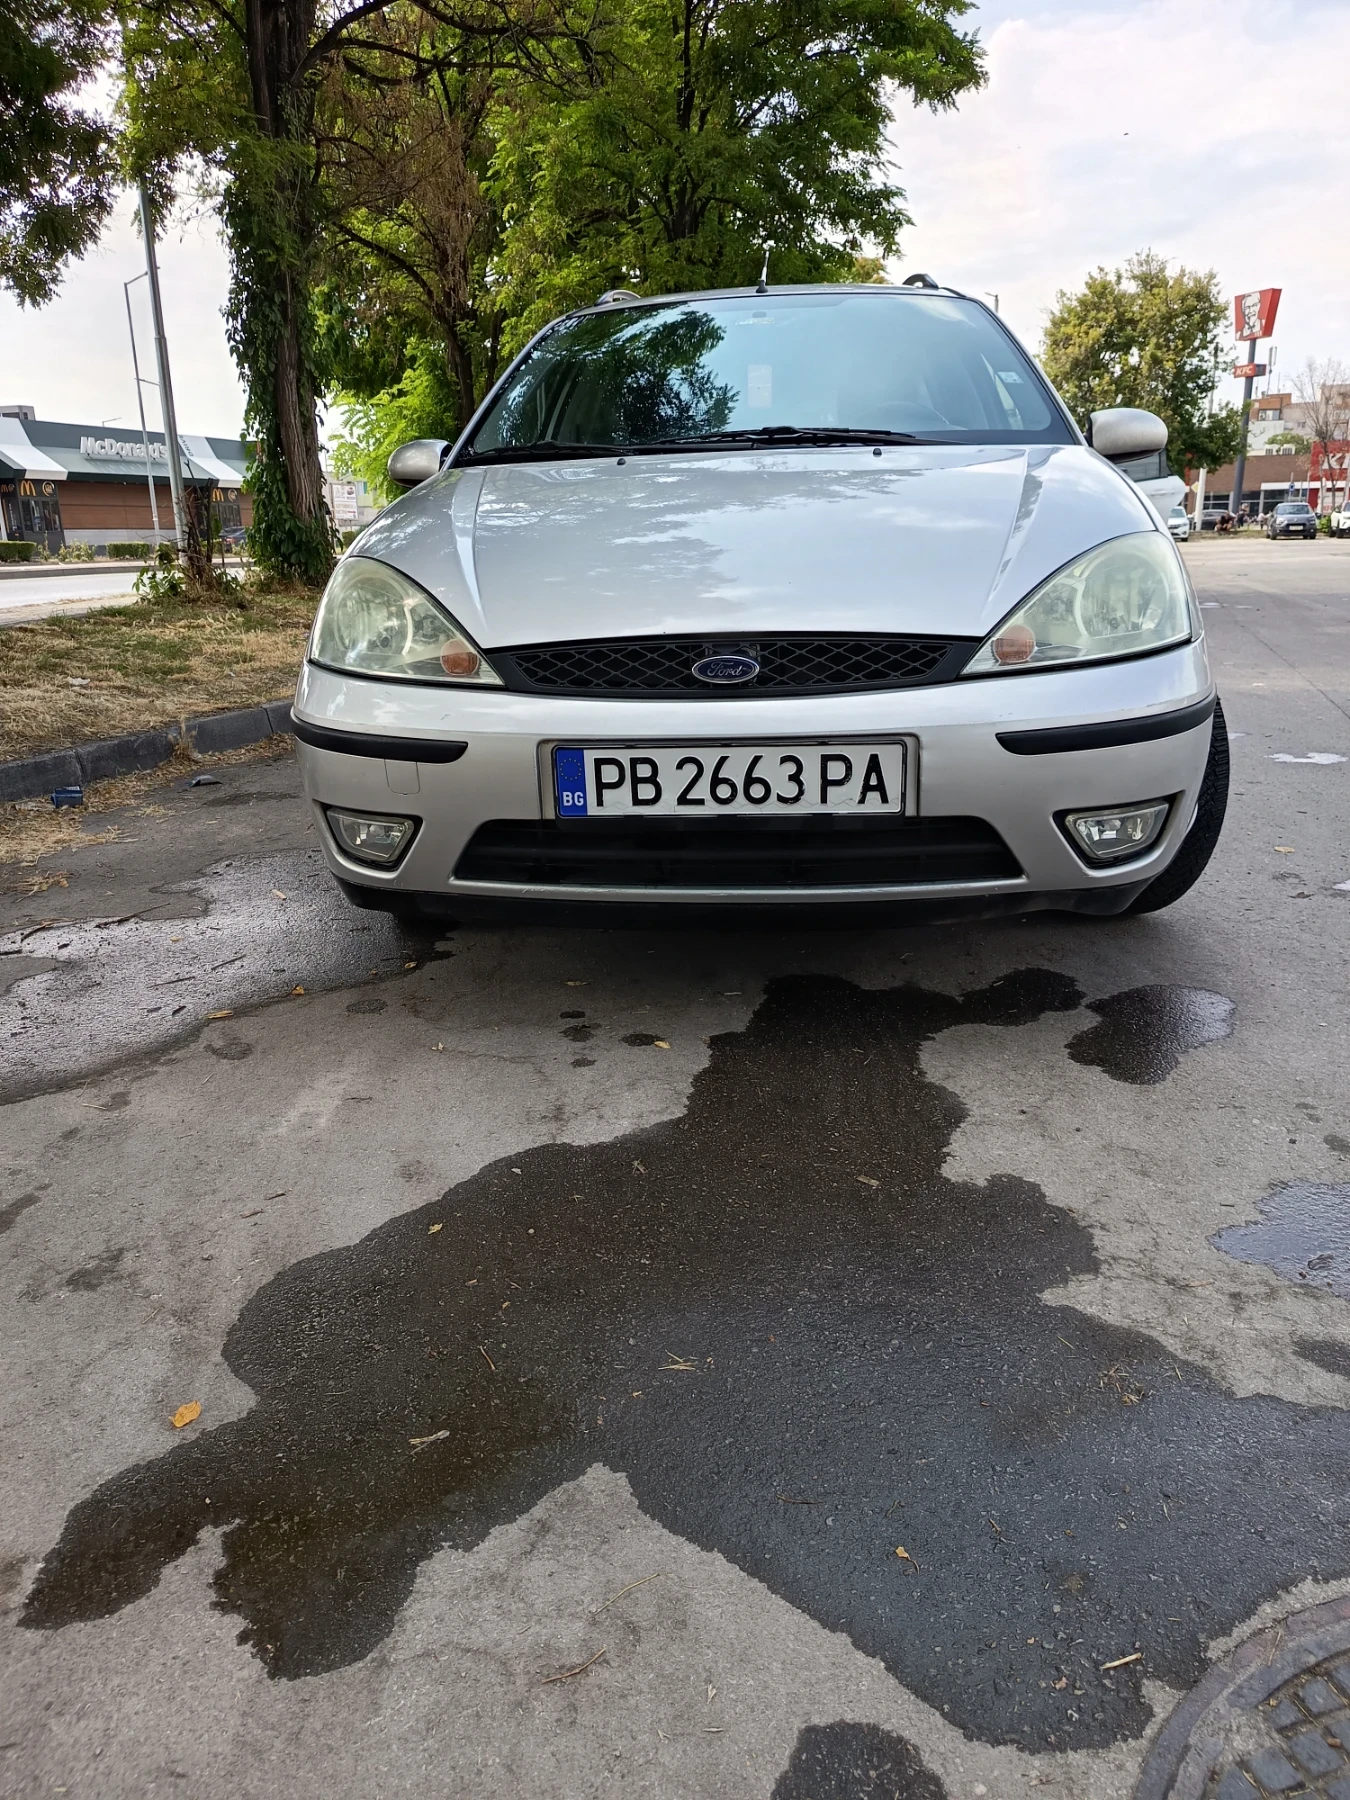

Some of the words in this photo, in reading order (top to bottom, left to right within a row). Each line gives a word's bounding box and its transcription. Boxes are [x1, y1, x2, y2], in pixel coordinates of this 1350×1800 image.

[1235, 365, 1254, 376] KFC
[80, 436, 168, 457] McDonad's
[707, 661, 743, 676] Ford
[593, 757, 662, 807] PB
[675, 754, 806, 806] 2663
[820, 752, 889, 805] PA
[562, 791, 584, 806] BG
